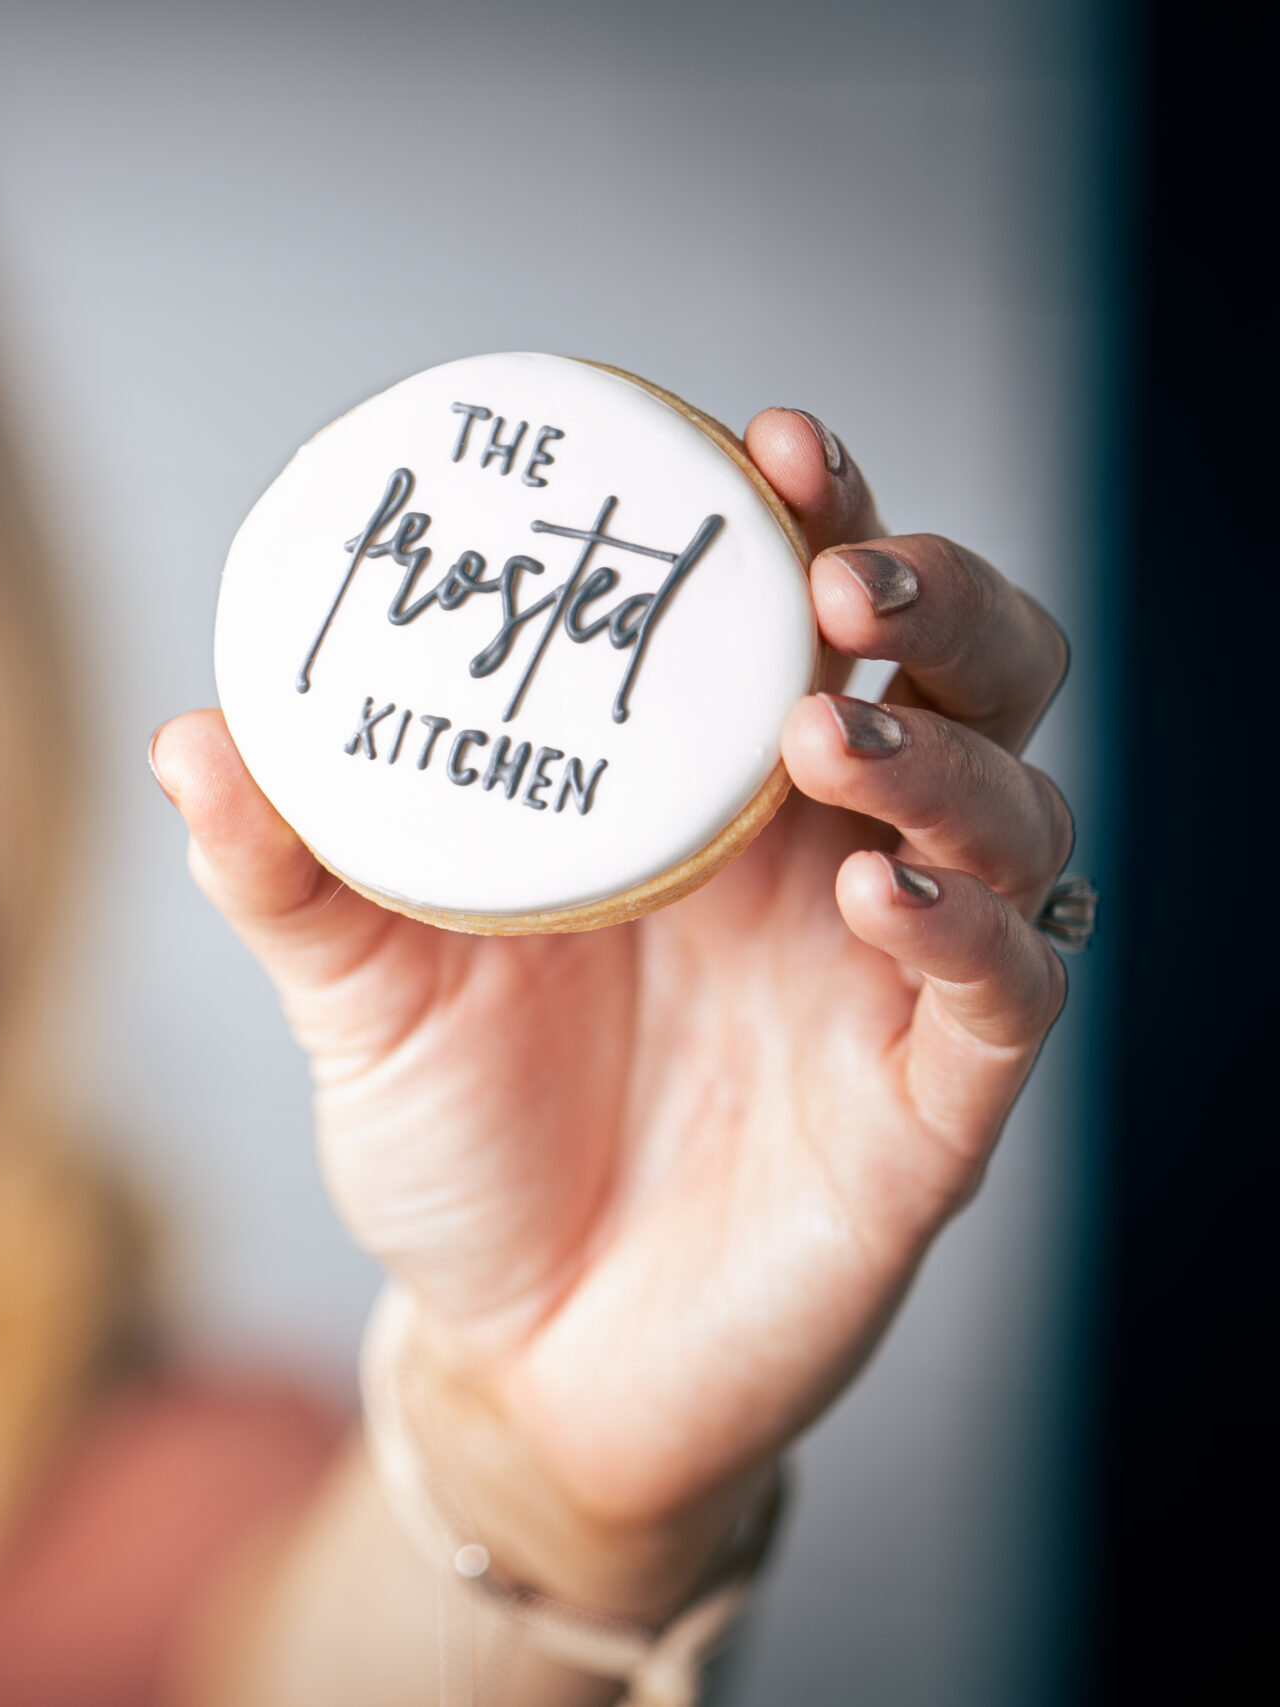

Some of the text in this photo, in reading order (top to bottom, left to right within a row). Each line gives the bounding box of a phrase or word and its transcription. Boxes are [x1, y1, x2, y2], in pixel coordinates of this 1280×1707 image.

[451, 402, 565, 488] THE
[295, 467, 725, 724] frosted
[343, 696, 609, 816] KITCHEN
